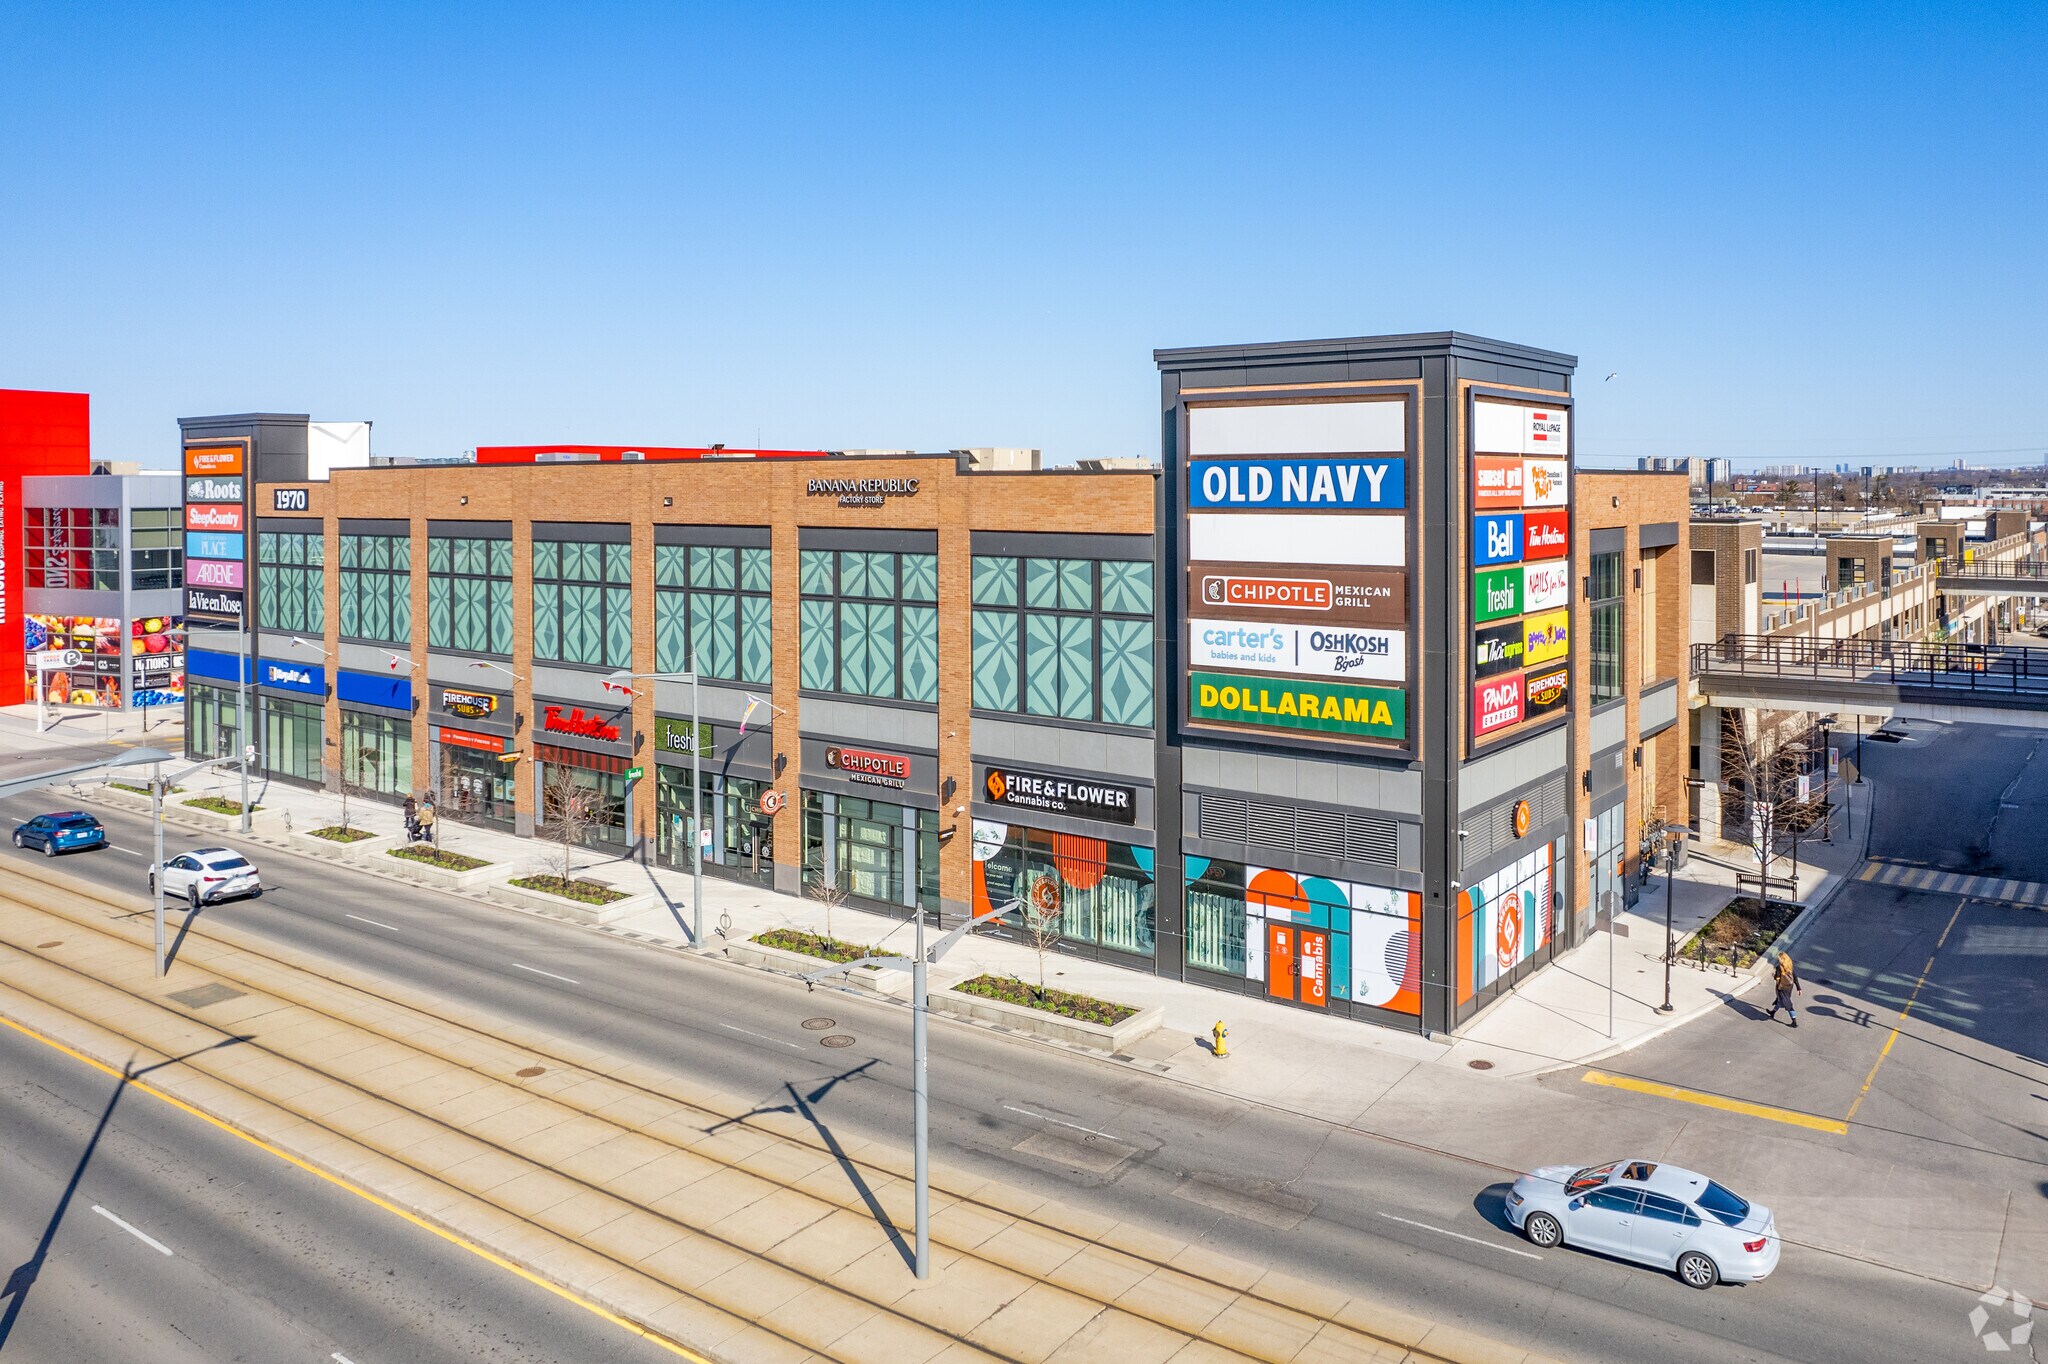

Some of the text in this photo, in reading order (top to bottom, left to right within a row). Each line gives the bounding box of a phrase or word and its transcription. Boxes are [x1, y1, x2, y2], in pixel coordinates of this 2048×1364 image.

[204, 480, 240, 499] Roots
[808, 478, 918, 492] BANANA REPUBLIC
[1202, 464, 1389, 502] OLD NAVY
[277, 491, 305, 509] 1970
[1488, 520, 1513, 558] Bell
[1528, 524, 1565, 546] Tim Hortons
[202, 542, 227, 556] PLACE
[196, 564, 233, 584] ARDENE
[1529, 571, 1548, 595] NAILS
[1231, 584, 1391, 603] CHIPOTLE MEXICAN
[1335, 597, 1370, 608] GRILL
[1487, 576, 1514, 612] freshii
[220, 594, 240, 614] Rose
[1203, 628, 1284, 650] carter's
[135, 657, 169, 671] NTIONS
[1211, 650, 1276, 663] babies and kids
[1334, 655, 1364, 672] B'gosh
[1528, 672, 1567, 701] FIREHOUSE
[1541, 688, 1555, 700] SUBS
[443, 692, 490, 712] FIREHOUSE
[1200, 685, 1393, 726] DOLLARAMA
[1483, 682, 1518, 713] PANDA
[456, 704, 474, 713] SUBS
[1485, 709, 1516, 726] EXPRESS
[667, 725, 695, 751] freshi
[842, 754, 903, 774] CHIPOTLE
[852, 774, 904, 788] MEXICAN GRILL
[1006, 775, 1127, 808] FIRE&FLOWER
[1007, 792, 1066, 810] Cannabis co.
[986, 861, 1012, 872] elcome
[1313, 936, 1323, 997] Cannabis
